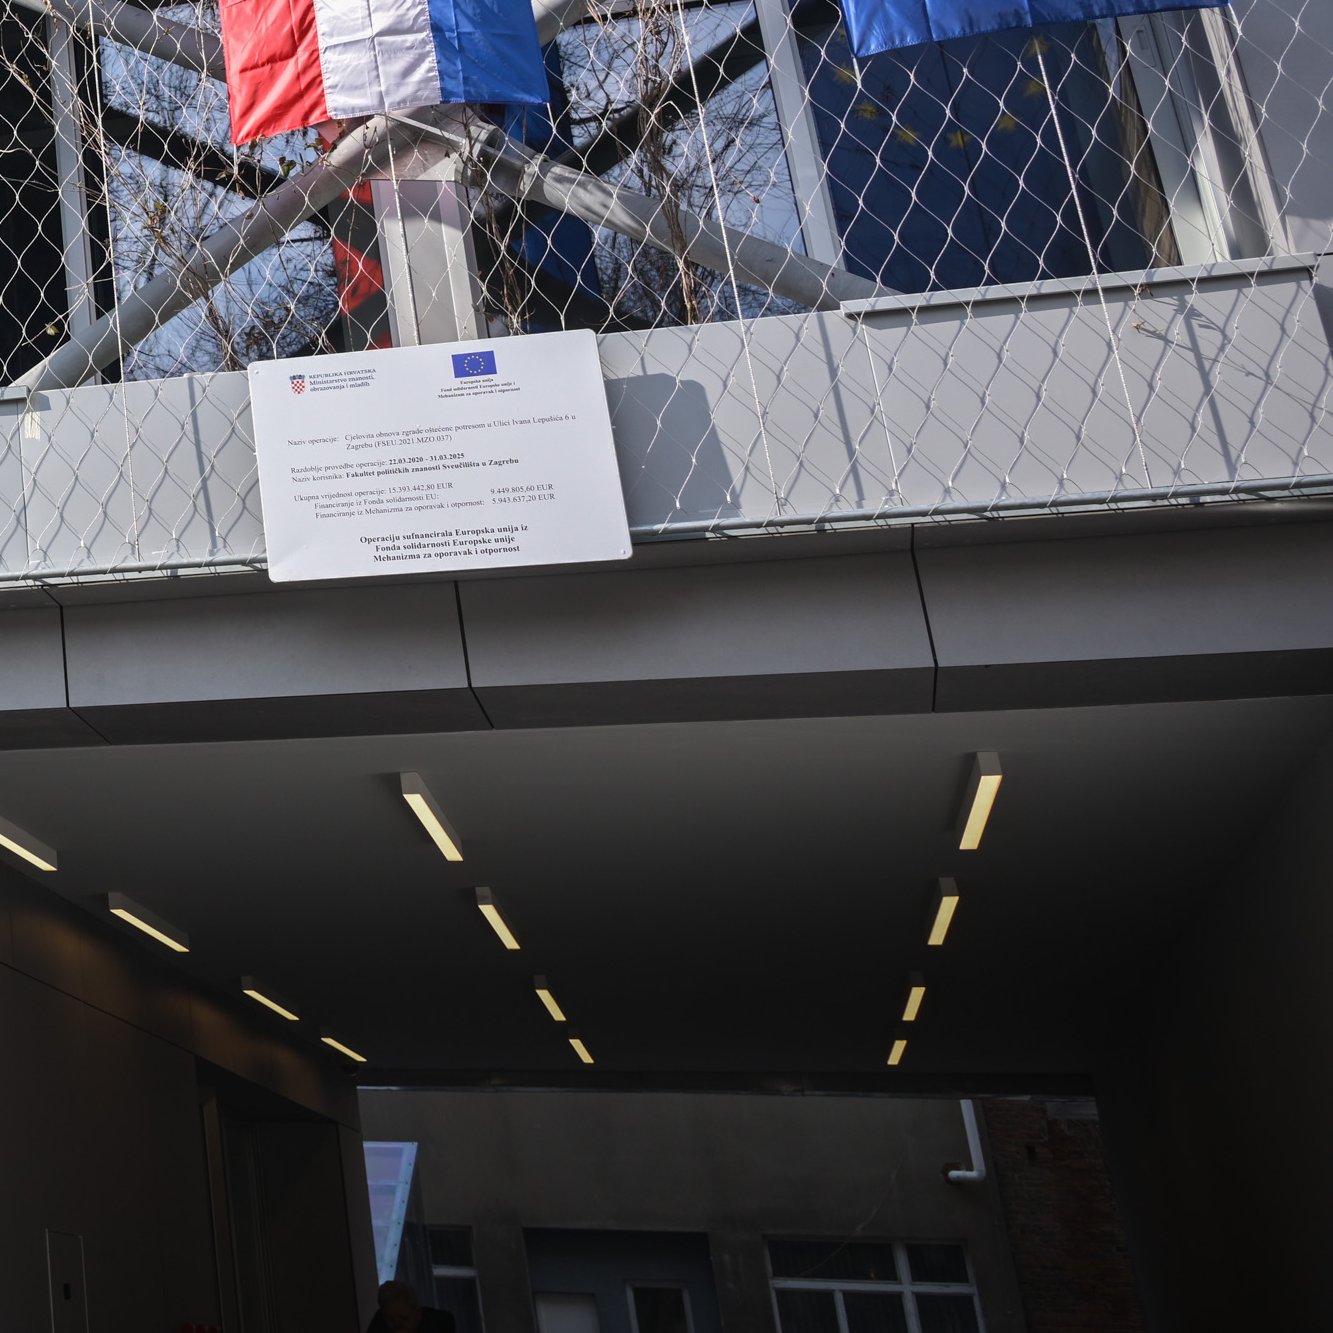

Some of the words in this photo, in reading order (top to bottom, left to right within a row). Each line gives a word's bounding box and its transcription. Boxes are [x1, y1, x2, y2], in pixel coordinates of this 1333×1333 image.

[344, 368, 376, 376] HRVATSKA
[288, 438, 306, 446] Naziv
[308, 437, 339, 445] operacije:
[345, 432, 374, 441] Cjelovita
[402, 428, 423, 437] zgrade
[425, 425, 453, 433] oštećene
[455, 423, 485, 431] potresom
[533, 416, 563, 424] Lepušića
[346, 442, 372, 450] Zagrebu
[291, 466, 322, 474] Razdoblje
[325, 463, 354, 472] provedbe
[356, 461, 387, 470] operacije:
[389, 456, 423, 465] 22.03.2020
[430, 453, 464, 461] 31.03.2025
[292, 475, 310, 483] Naziv
[312, 472, 344, 481] korisnika:
[377, 468, 409, 477] političkih
[411, 465, 440, 473] znanosti
[489, 458, 519, 466] Zagrebu
[294, 494, 319, 502] Ukupna
[321, 490, 353, 500] vrijednost
[355, 488, 386, 497] operacije:
[315, 500, 354, 509] Financiranje
[386, 495, 423, 503] solidarnosti
[316, 510, 355, 518] Financiranje
[365, 506, 403, 514] Mehanizma
[414, 502, 444, 510] oporavak
[360, 534, 400, 544] Operaciju
[455, 527, 495, 536] Europska
[497, 525, 518, 533] unija
[375, 544, 401, 552] Fonda
[403, 540, 450, 550] solidarnosti
[453, 538, 491, 546] Europske
[495, 535, 515, 544] unije
[373, 552, 420, 562] Mehanizma
[434, 548, 473, 558] oporavak
[481, 545, 520, 554] otpornost
